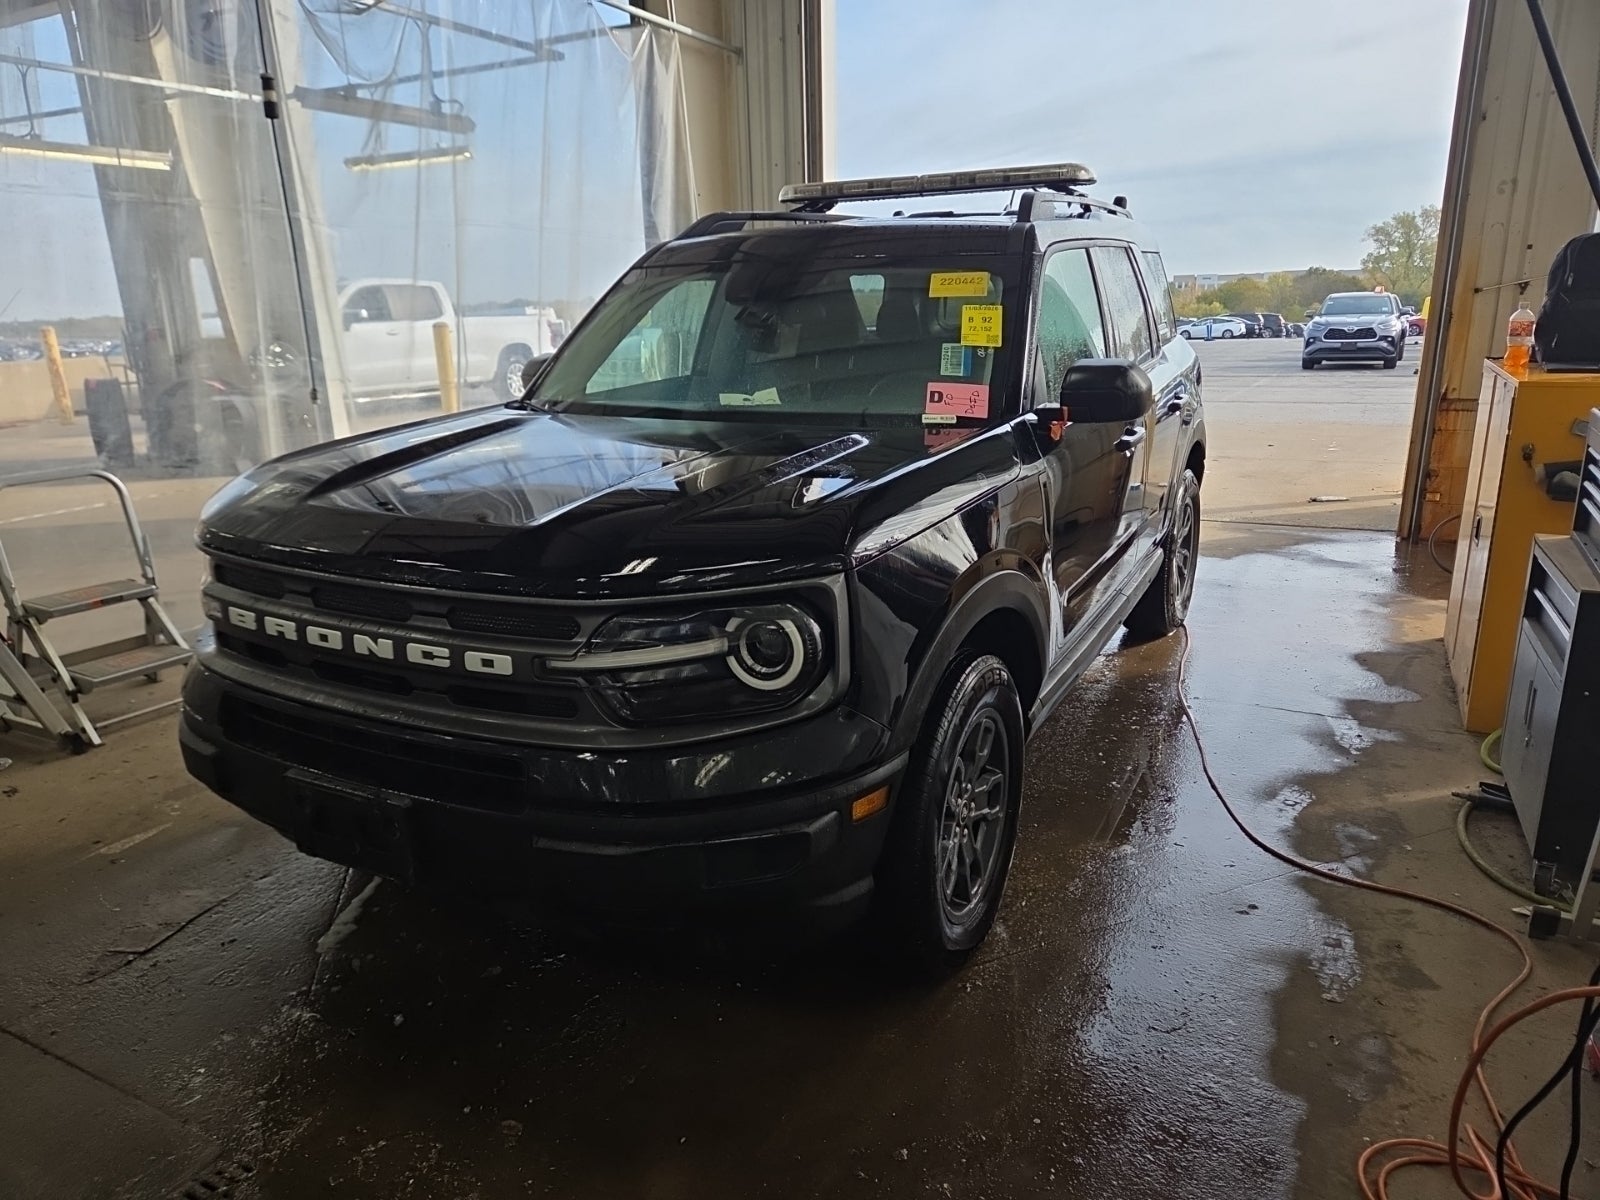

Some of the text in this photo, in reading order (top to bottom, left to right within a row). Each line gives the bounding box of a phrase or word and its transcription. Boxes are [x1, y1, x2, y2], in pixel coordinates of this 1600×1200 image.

[939, 276, 984, 286] 220442
[981, 316, 993, 324] 92
[929, 390, 944, 404] D
[227, 606, 513, 676] BRONCO
